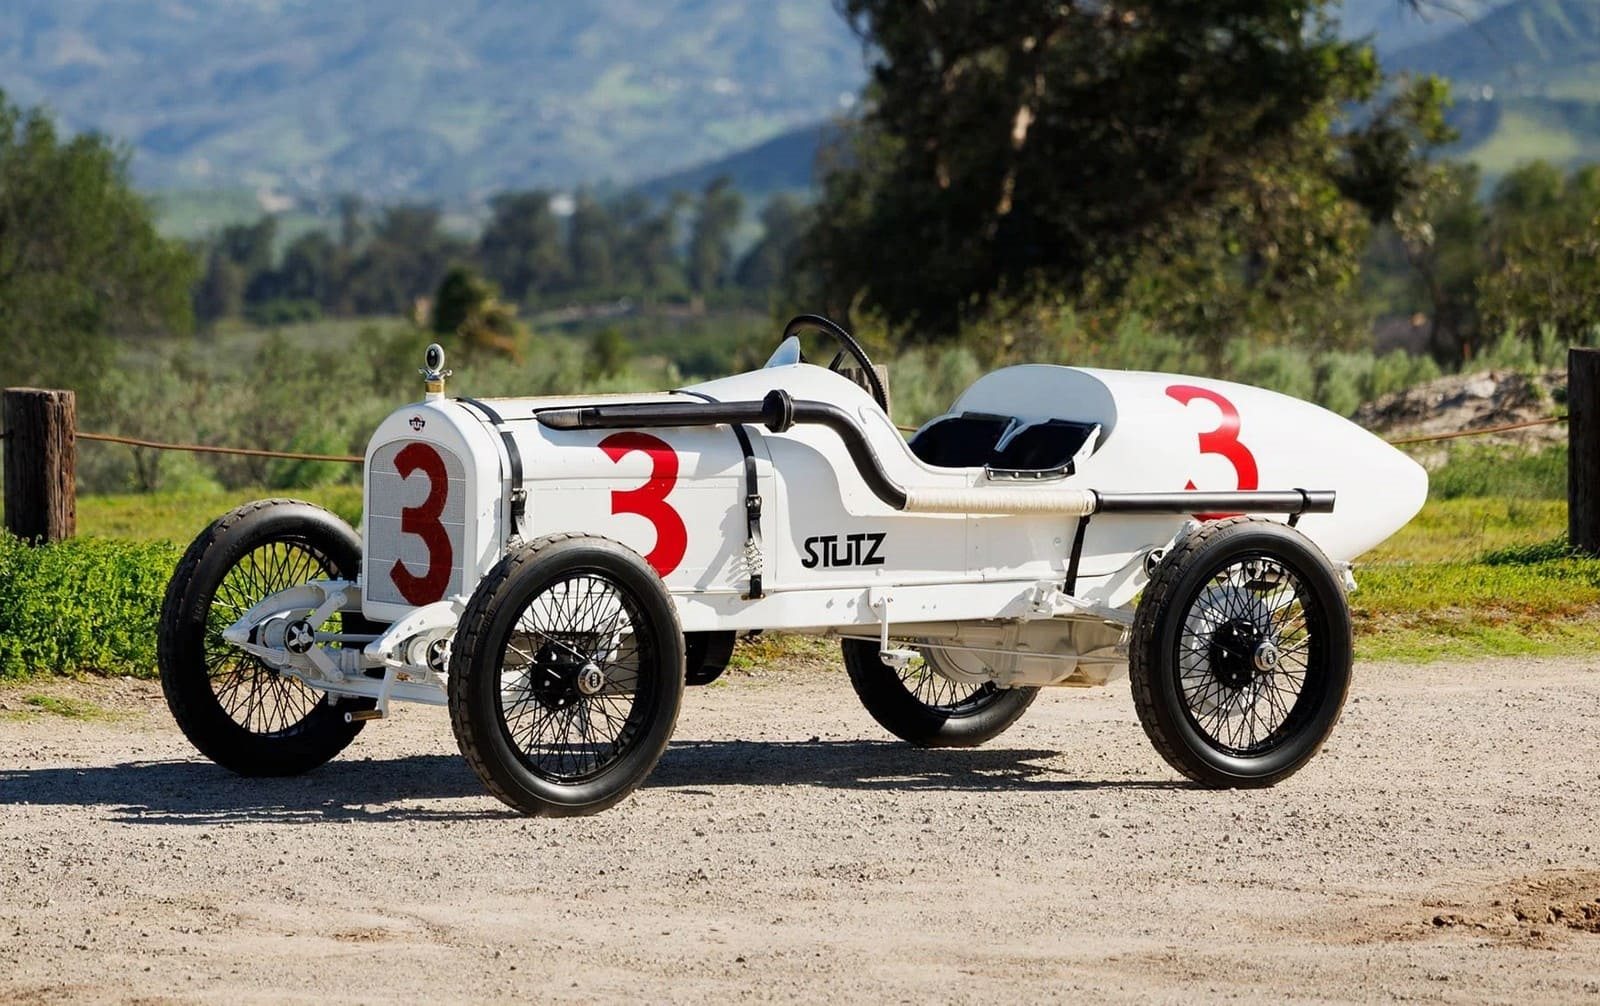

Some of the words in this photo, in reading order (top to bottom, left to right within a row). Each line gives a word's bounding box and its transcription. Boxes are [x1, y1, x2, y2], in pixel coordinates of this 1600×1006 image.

[390, 442, 452, 607] 3
[597, 431, 687, 579] 3
[1165, 385, 1258, 523] 3
[801, 533, 887, 569] STUTZ
